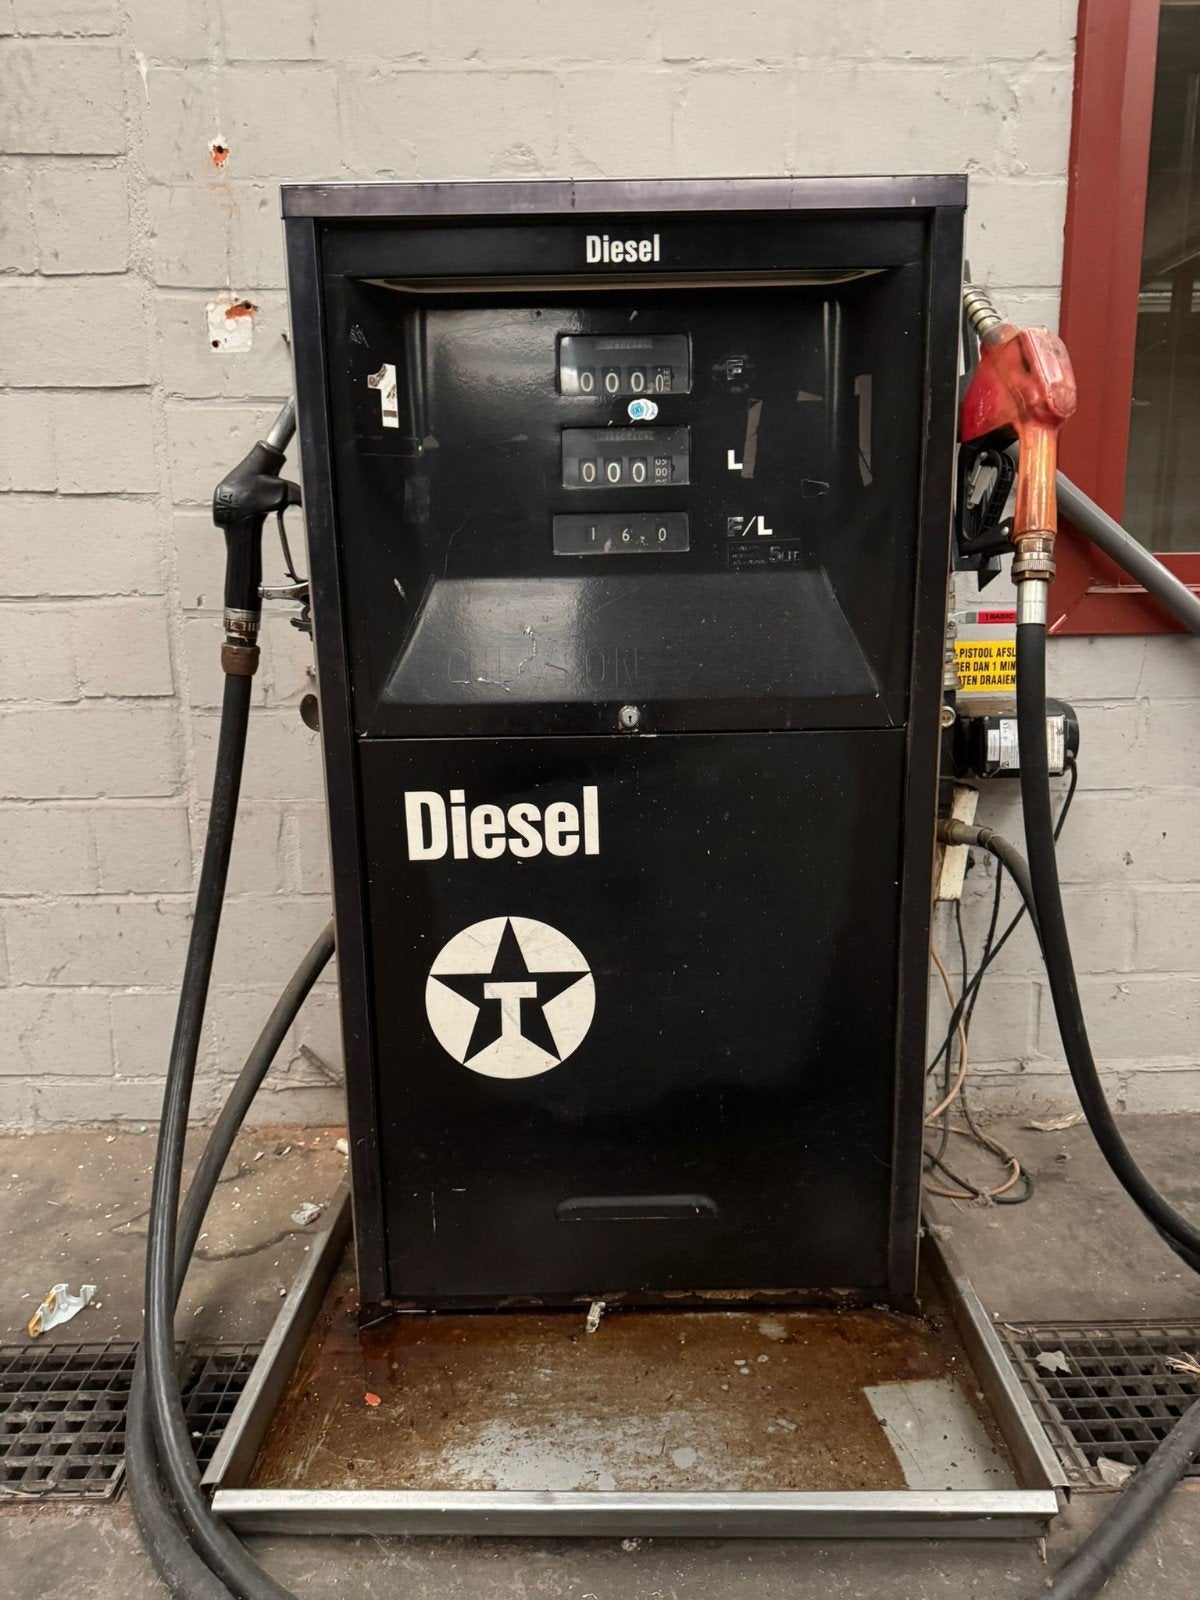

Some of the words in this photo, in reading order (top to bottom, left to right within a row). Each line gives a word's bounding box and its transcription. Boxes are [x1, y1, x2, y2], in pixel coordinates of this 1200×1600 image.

[586, 233, 660, 263] Diesel
[367, 363, 400, 428] 1
[727, 450, 743, 470] L
[959, 648, 993, 658] PISTOOL
[973, 661, 990, 672] DAN
[1000, 661, 1016, 671] MIN
[980, 674, 1016, 685] DRAAIEN
[404, 785, 600, 861] Diesel
